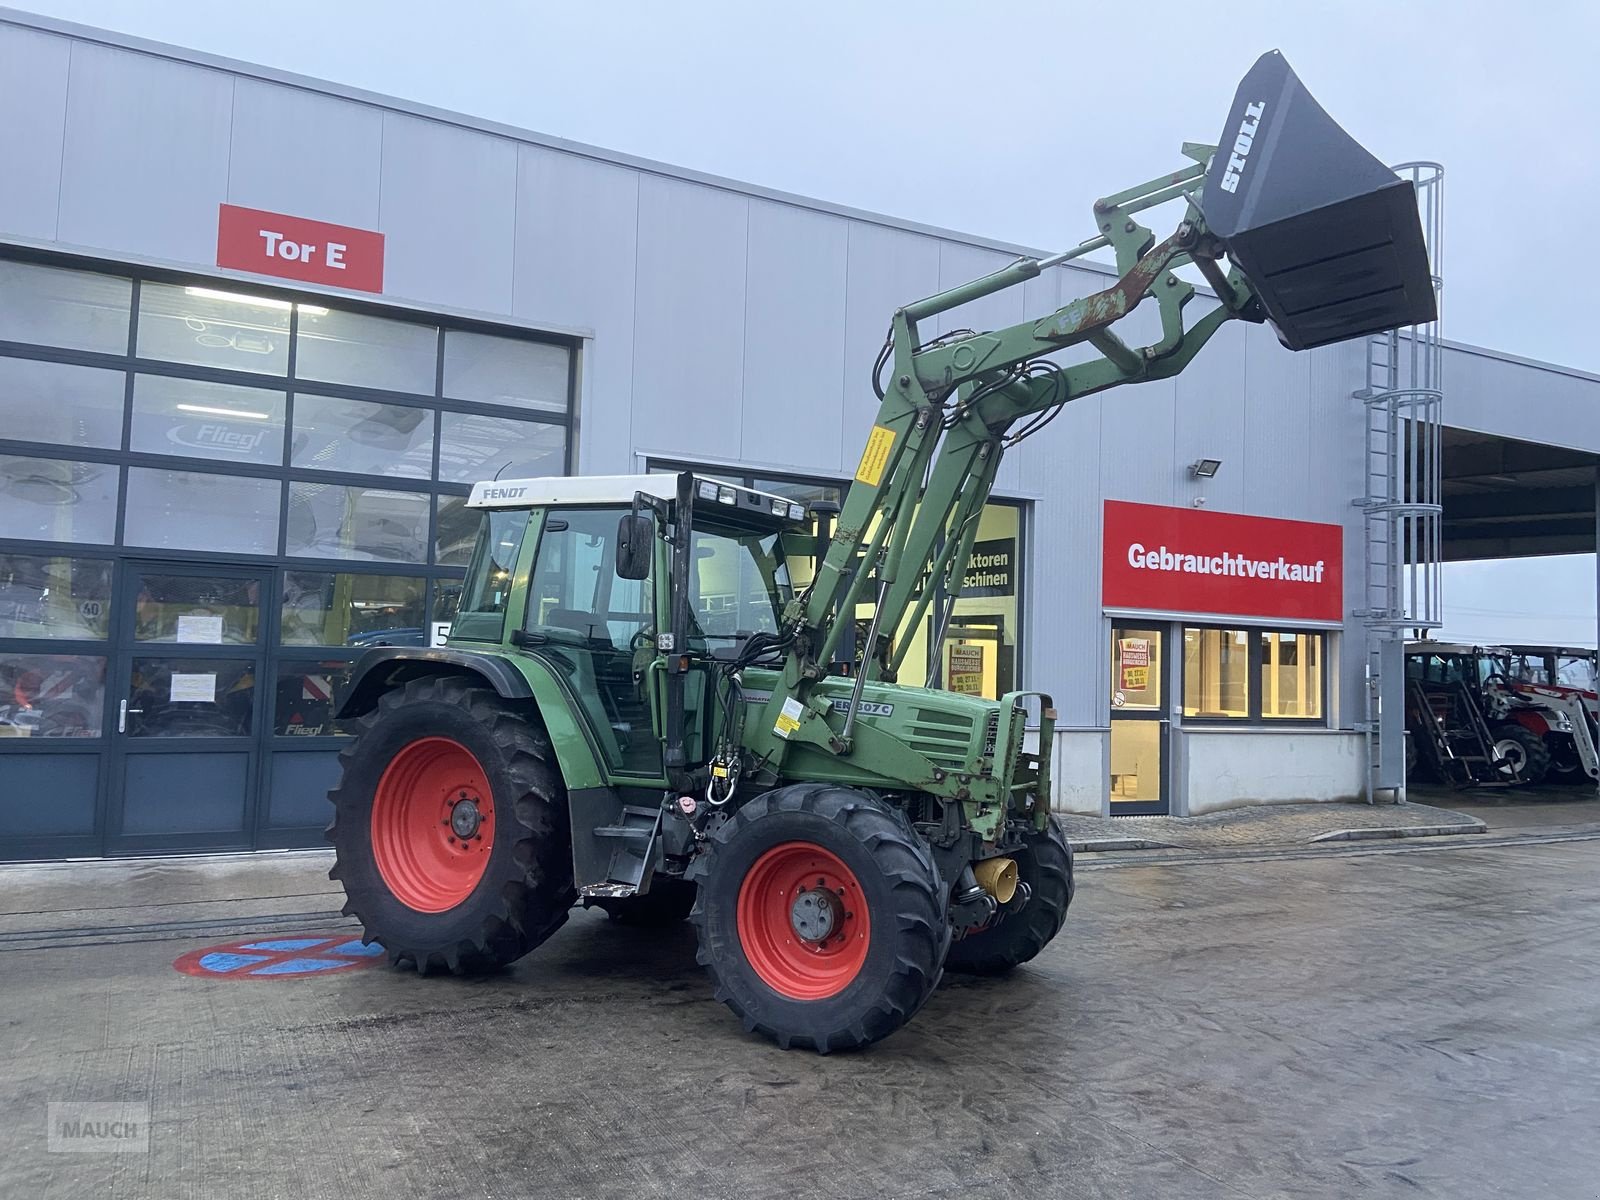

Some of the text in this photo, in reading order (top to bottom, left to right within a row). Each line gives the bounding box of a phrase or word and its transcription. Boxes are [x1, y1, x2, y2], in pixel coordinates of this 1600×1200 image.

[1221, 101, 1266, 194] STOLL
[259, 229, 347, 270] Tor E
[196, 424, 265, 450] Fliegl
[483, 487, 528, 499] FENDT
[967, 553, 1008, 569] ktoren
[1127, 543, 1325, 584] Gebrauchtverkauf
[962, 571, 1008, 588] schinen
[83, 602, 99, 616] 40
[955, 648, 980, 656] MAUCH
[1126, 642, 1146, 650] MAUCH
[835, 700, 850, 710] ER
[285, 723, 323, 737] Fliegl
